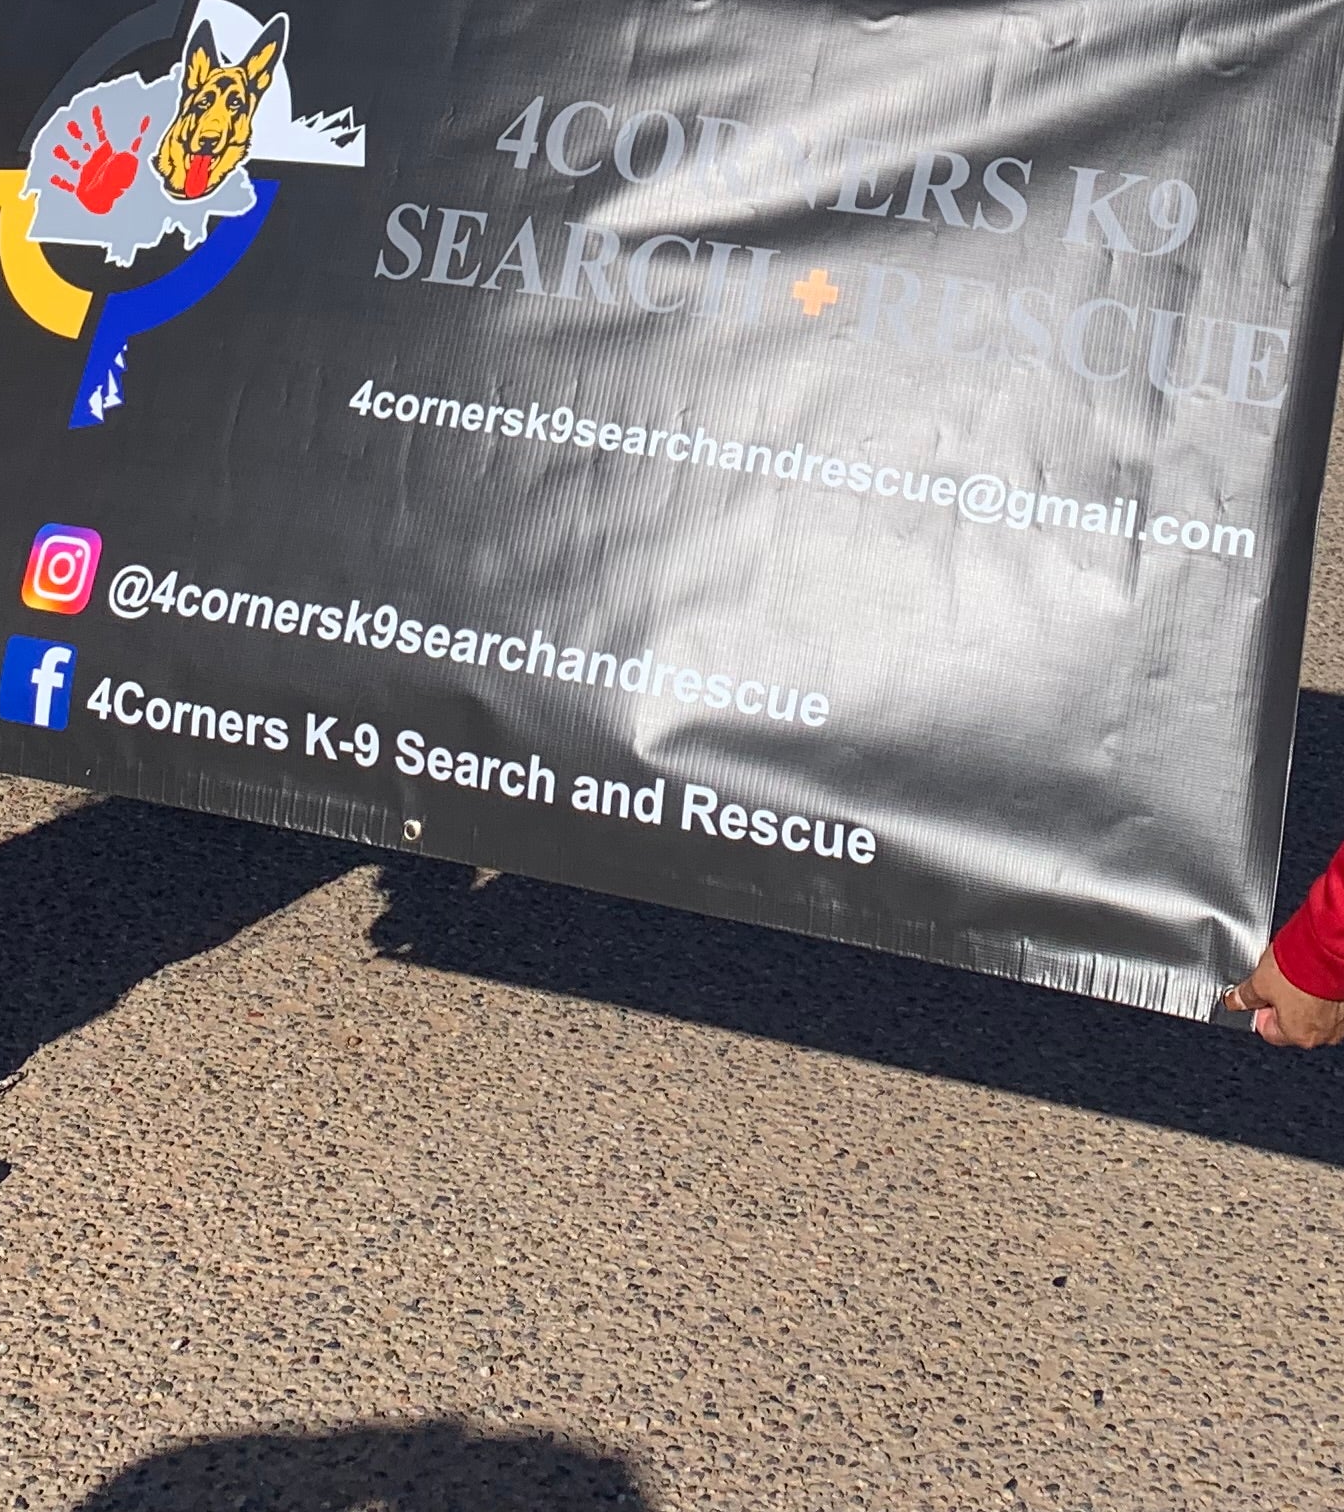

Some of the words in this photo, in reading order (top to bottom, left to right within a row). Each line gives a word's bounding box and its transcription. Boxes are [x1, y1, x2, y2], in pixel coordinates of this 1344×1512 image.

[496, 95, 1034, 233] 4CORNERS
[1059, 165, 1197, 256] K9
[374, 202, 781, 327] SEARCH
[854, 263, 1290, 409] RESCUE
[348, 379, 1256, 558] 4cornersk9searchandrescue@gmail.com
[108, 563, 831, 727] @4cornersk9searchandrescue
[86, 677, 289, 752] 4Corners
[304, 712, 380, 768] K-9
[394, 730, 555, 804] Search
[572, 766, 664, 824] and
[682, 783, 877, 866] Rescue
